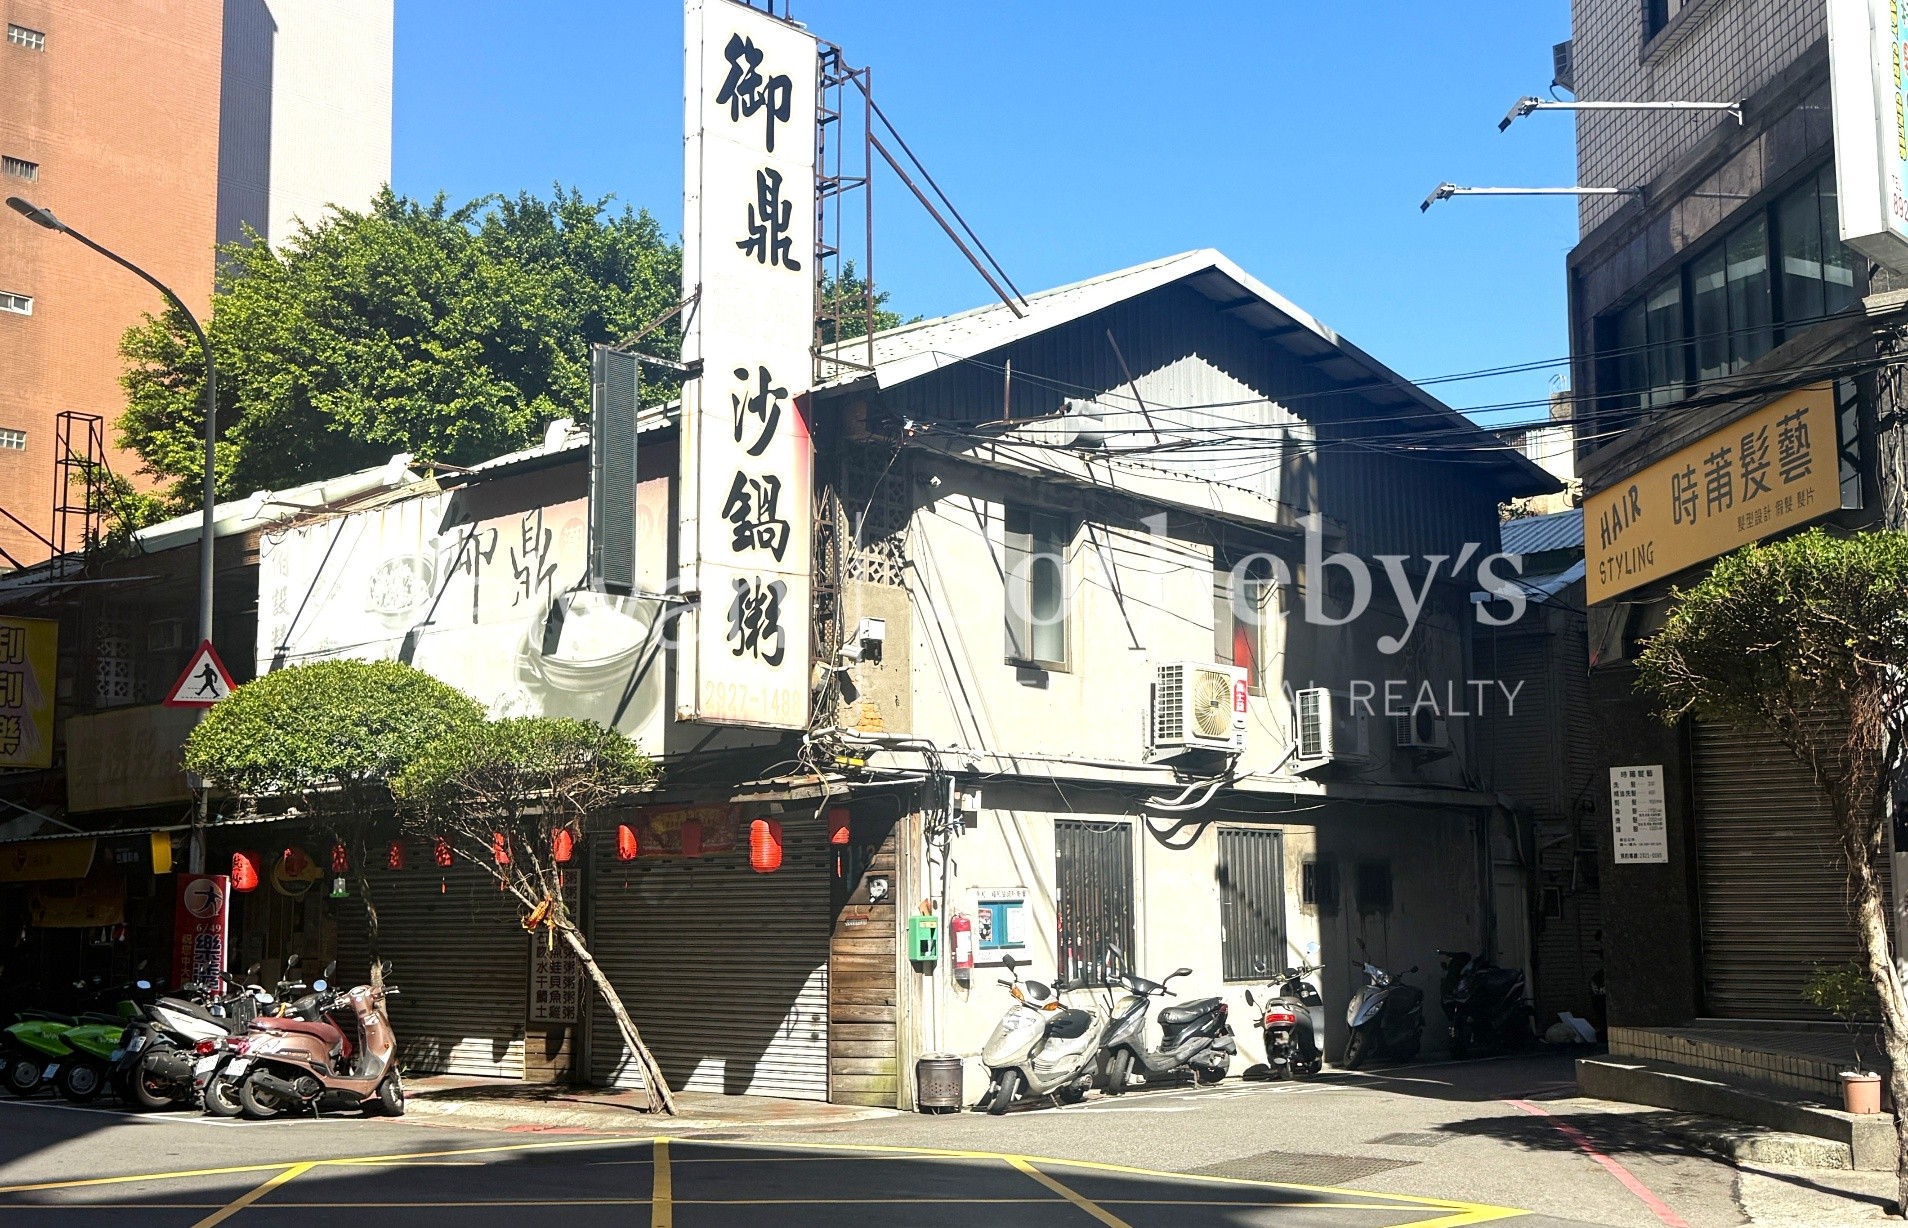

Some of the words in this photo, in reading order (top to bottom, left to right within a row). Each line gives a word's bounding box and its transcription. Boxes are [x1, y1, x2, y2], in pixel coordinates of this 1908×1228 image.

[716, 32, 801, 272] 御鼎
[1671, 407, 1813, 526] 時莆髮藝
[721, 367, 789, 667] 沙鍋粥
[1599, 540, 1655, 585] STYLING
[1600, 485, 1642, 550] HAIR
[196, 923, 222, 933] 6/49
